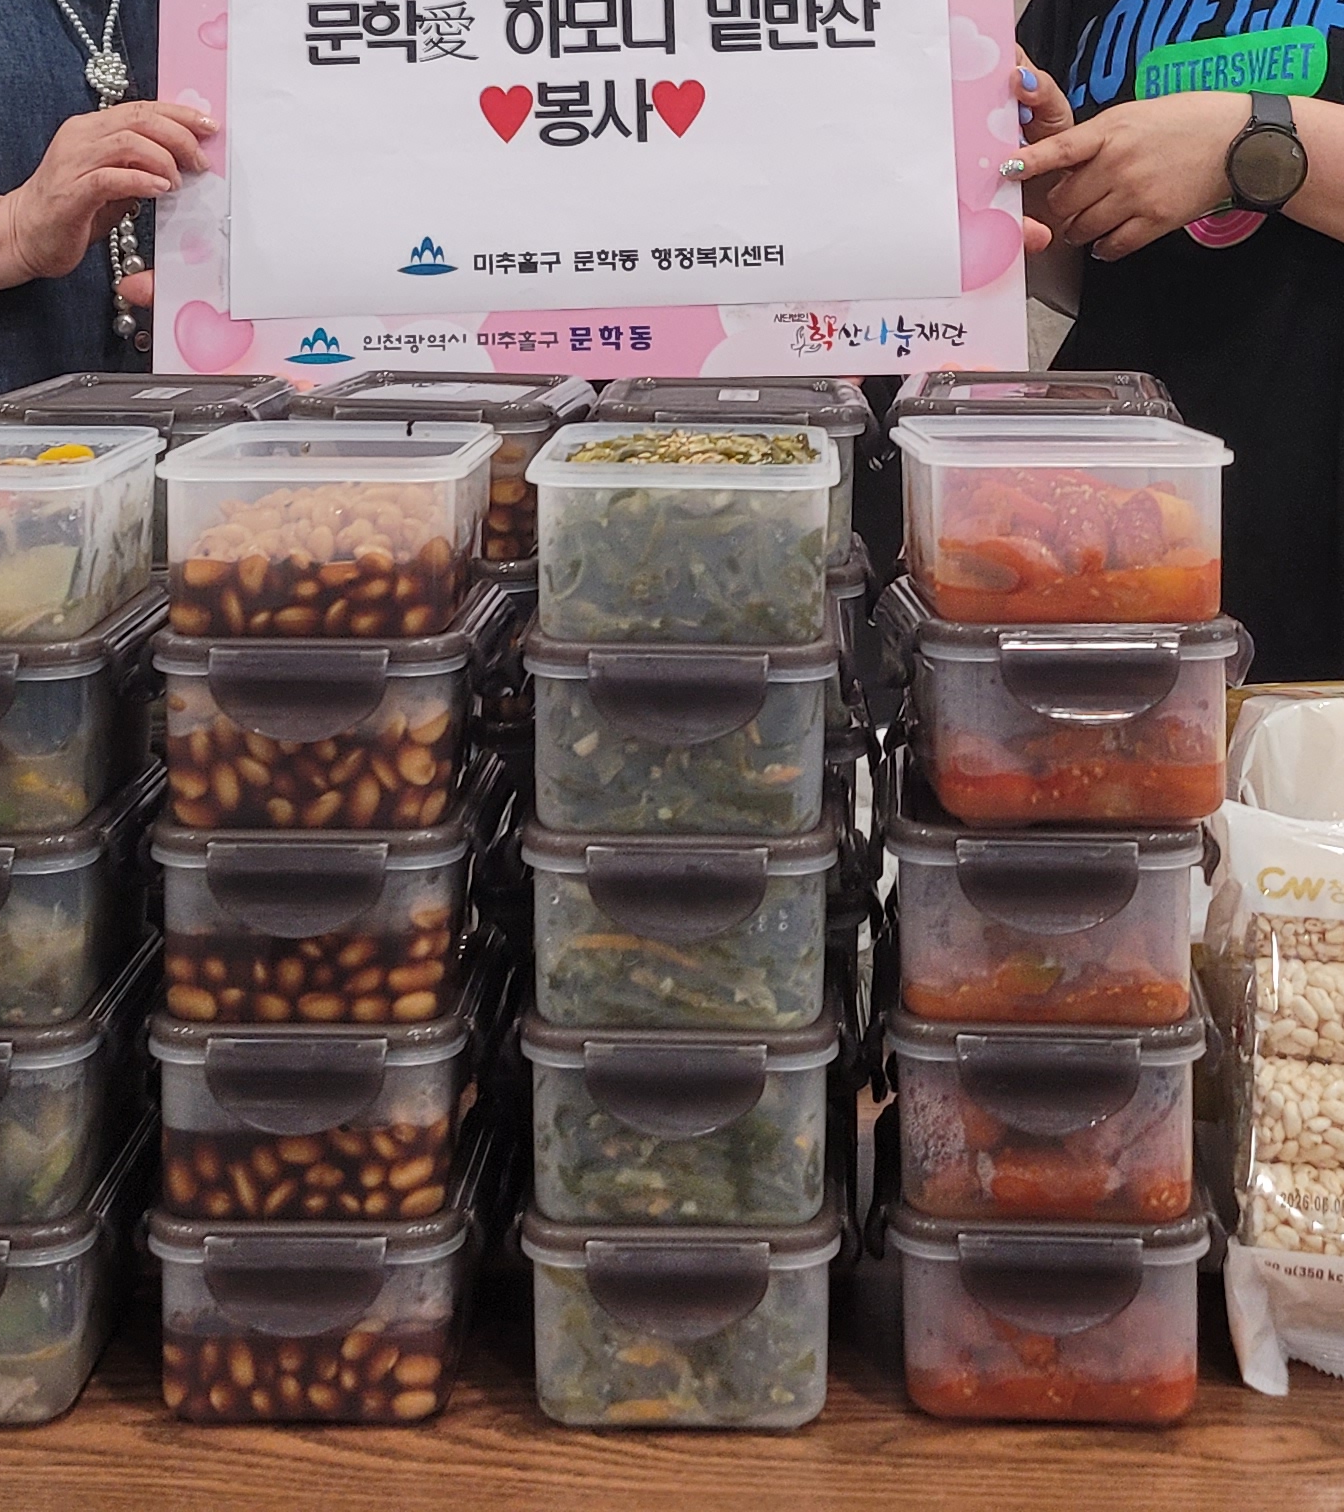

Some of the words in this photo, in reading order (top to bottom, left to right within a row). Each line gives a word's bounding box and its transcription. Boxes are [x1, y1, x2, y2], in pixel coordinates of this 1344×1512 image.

[1145, 42, 1316, 99] BITTERSWEET
[534, 77, 654, 148] 봉사
[473, 251, 562, 275] 미추홀구
[573, 249, 639, 272] 문학동
[650, 245, 785, 271] 행정복지센터
[362, 332, 467, 354] 인천광역시
[477, 331, 559, 352] 미추홀구
